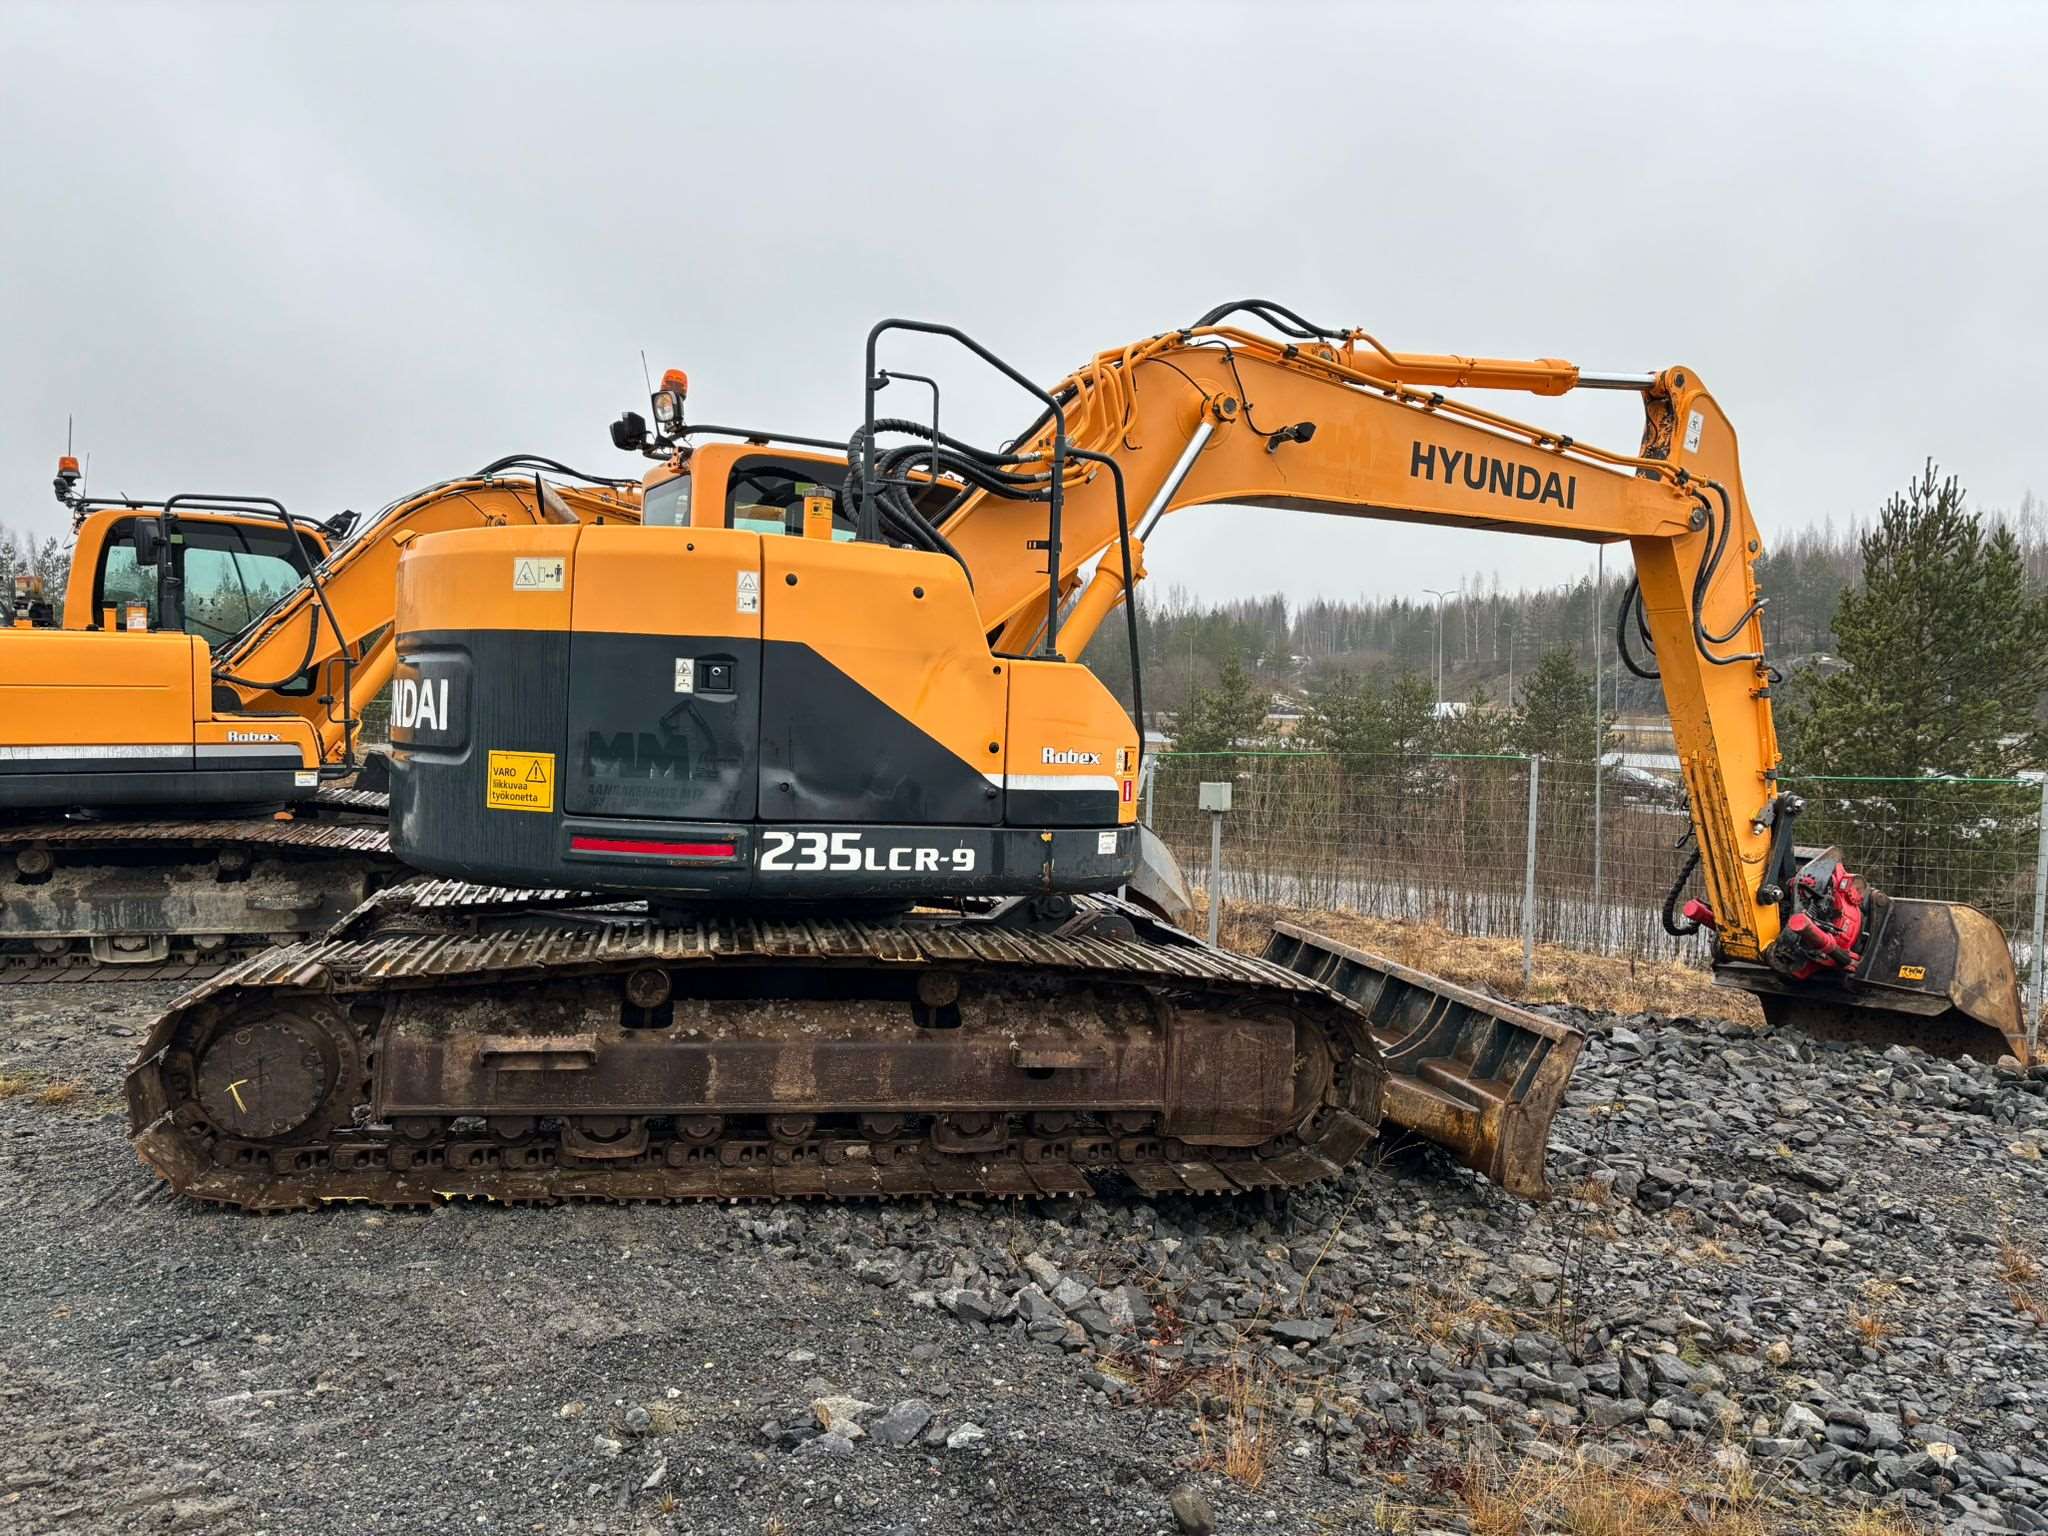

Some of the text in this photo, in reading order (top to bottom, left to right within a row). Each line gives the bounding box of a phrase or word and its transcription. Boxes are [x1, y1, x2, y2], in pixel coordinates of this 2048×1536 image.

[1410, 441, 1576, 510] HYUNDAI
[391, 678, 448, 730] NDAI
[228, 730, 280, 742] Robex
[1041, 746, 1102, 765] Robex
[493, 767, 517, 777] VARO
[493, 778, 528, 790] liikkuvaa
[492, 790, 538, 802] työkonetta
